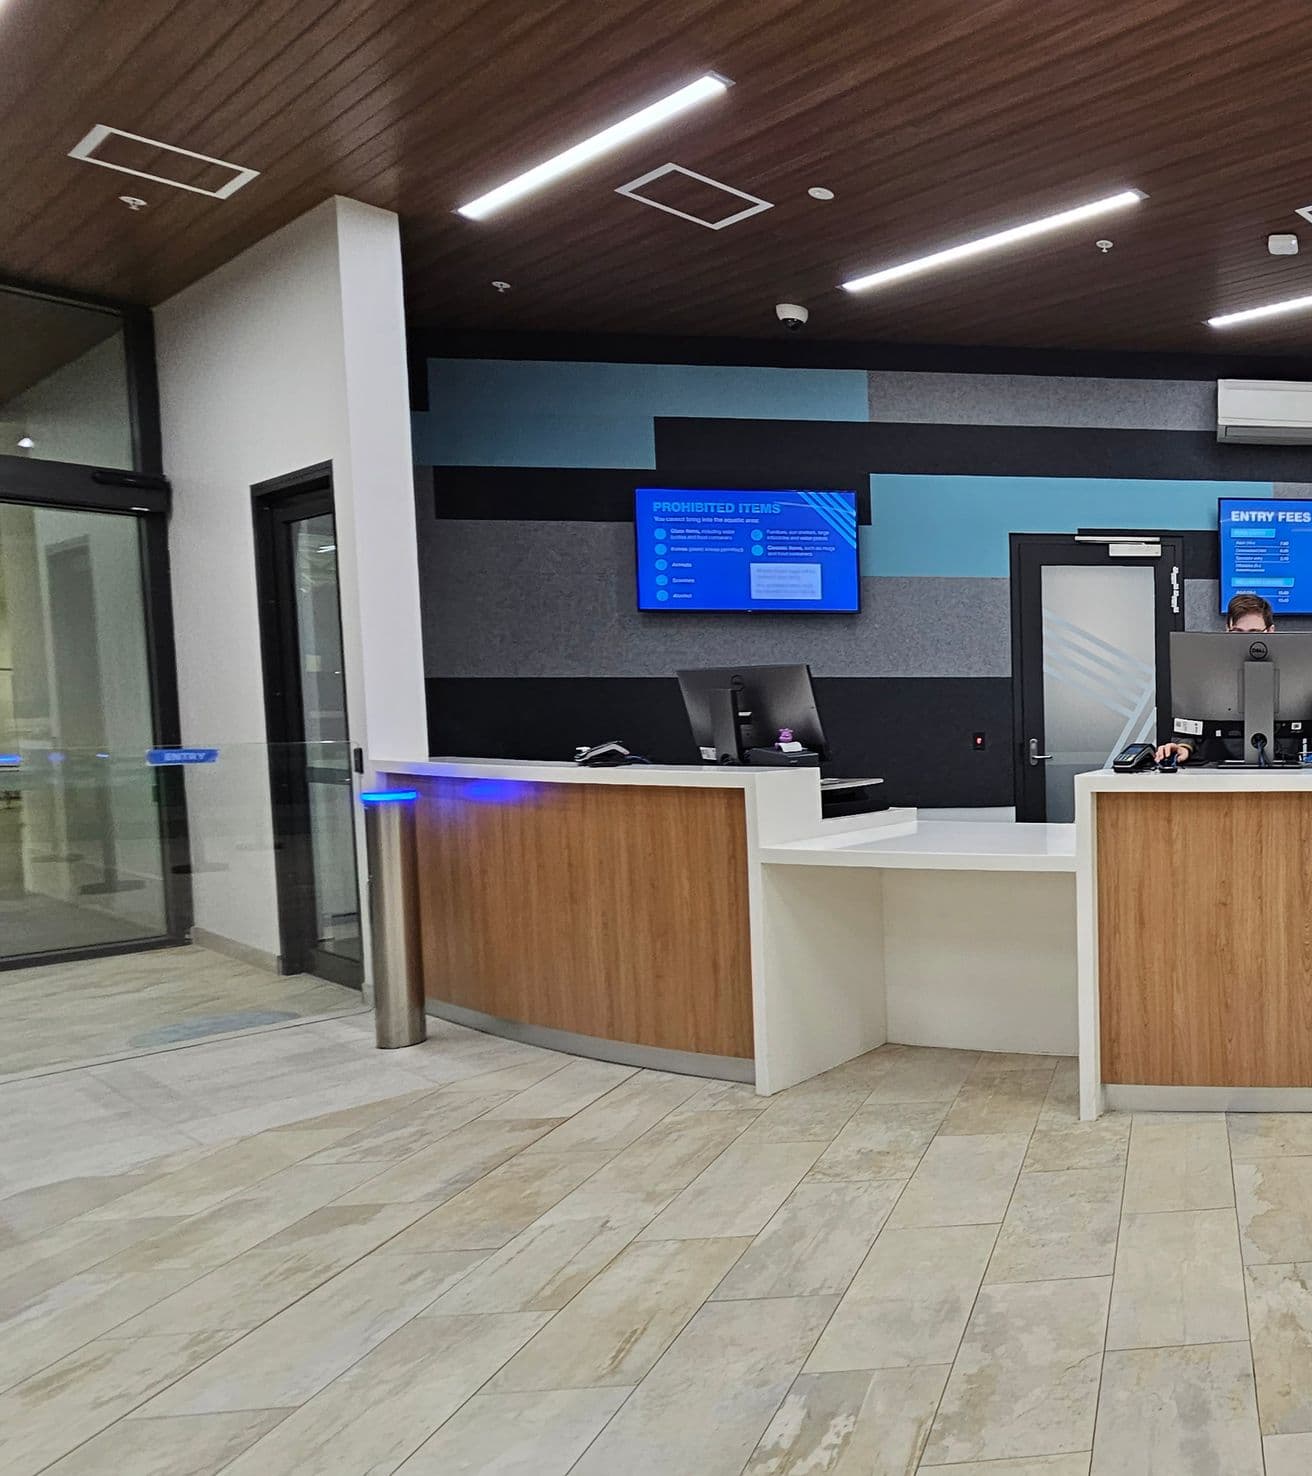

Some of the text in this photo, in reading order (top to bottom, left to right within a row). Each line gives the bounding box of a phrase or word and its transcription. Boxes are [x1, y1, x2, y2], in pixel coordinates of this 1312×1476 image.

[652, 501, 781, 515] PROHIBITED ITEMS
[1231, 510, 1312, 523] ENTRY FEES
[163, 752, 207, 761] ENTRY
